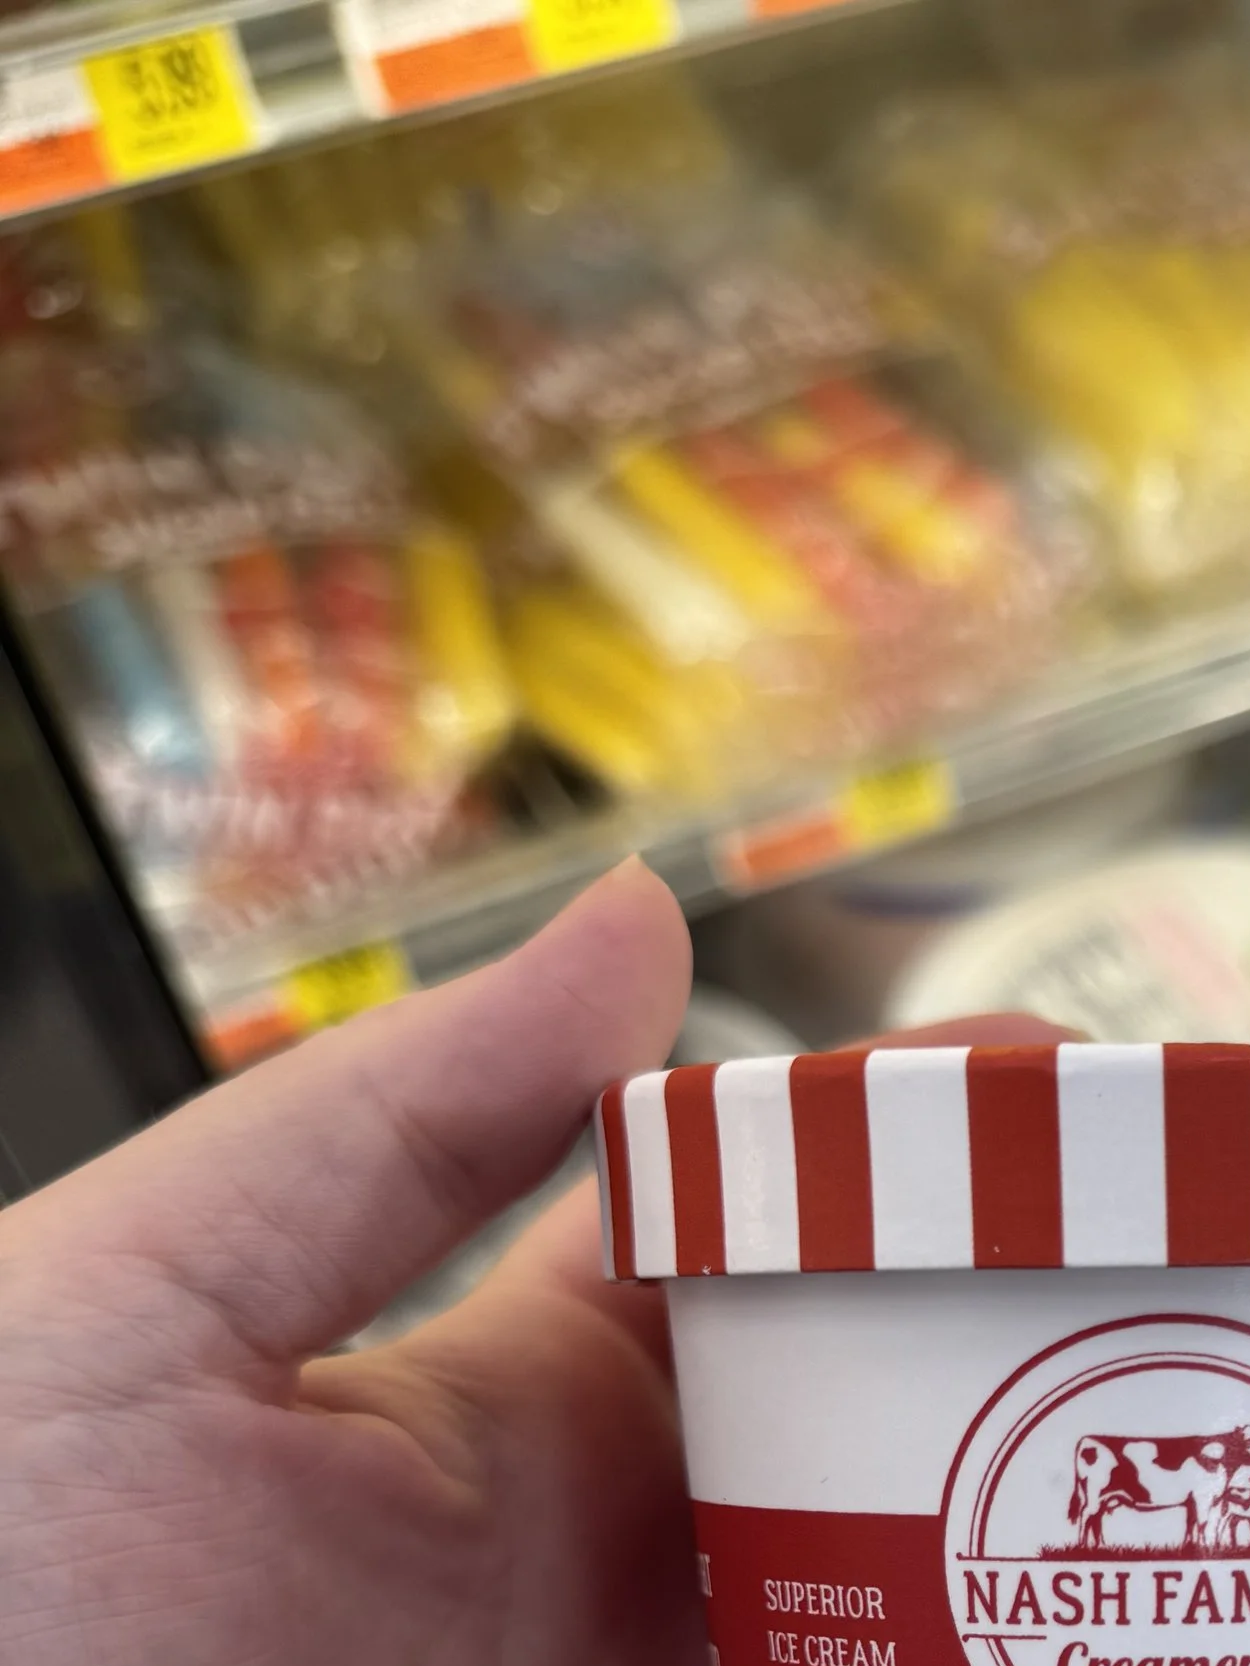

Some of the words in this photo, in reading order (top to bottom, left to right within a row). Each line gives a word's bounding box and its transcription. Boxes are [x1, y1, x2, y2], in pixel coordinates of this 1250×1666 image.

[764, 1578, 887, 1620] SUPERIOR
[963, 1569, 1131, 1627] NASH
[766, 1630, 801, 1665] ICE
